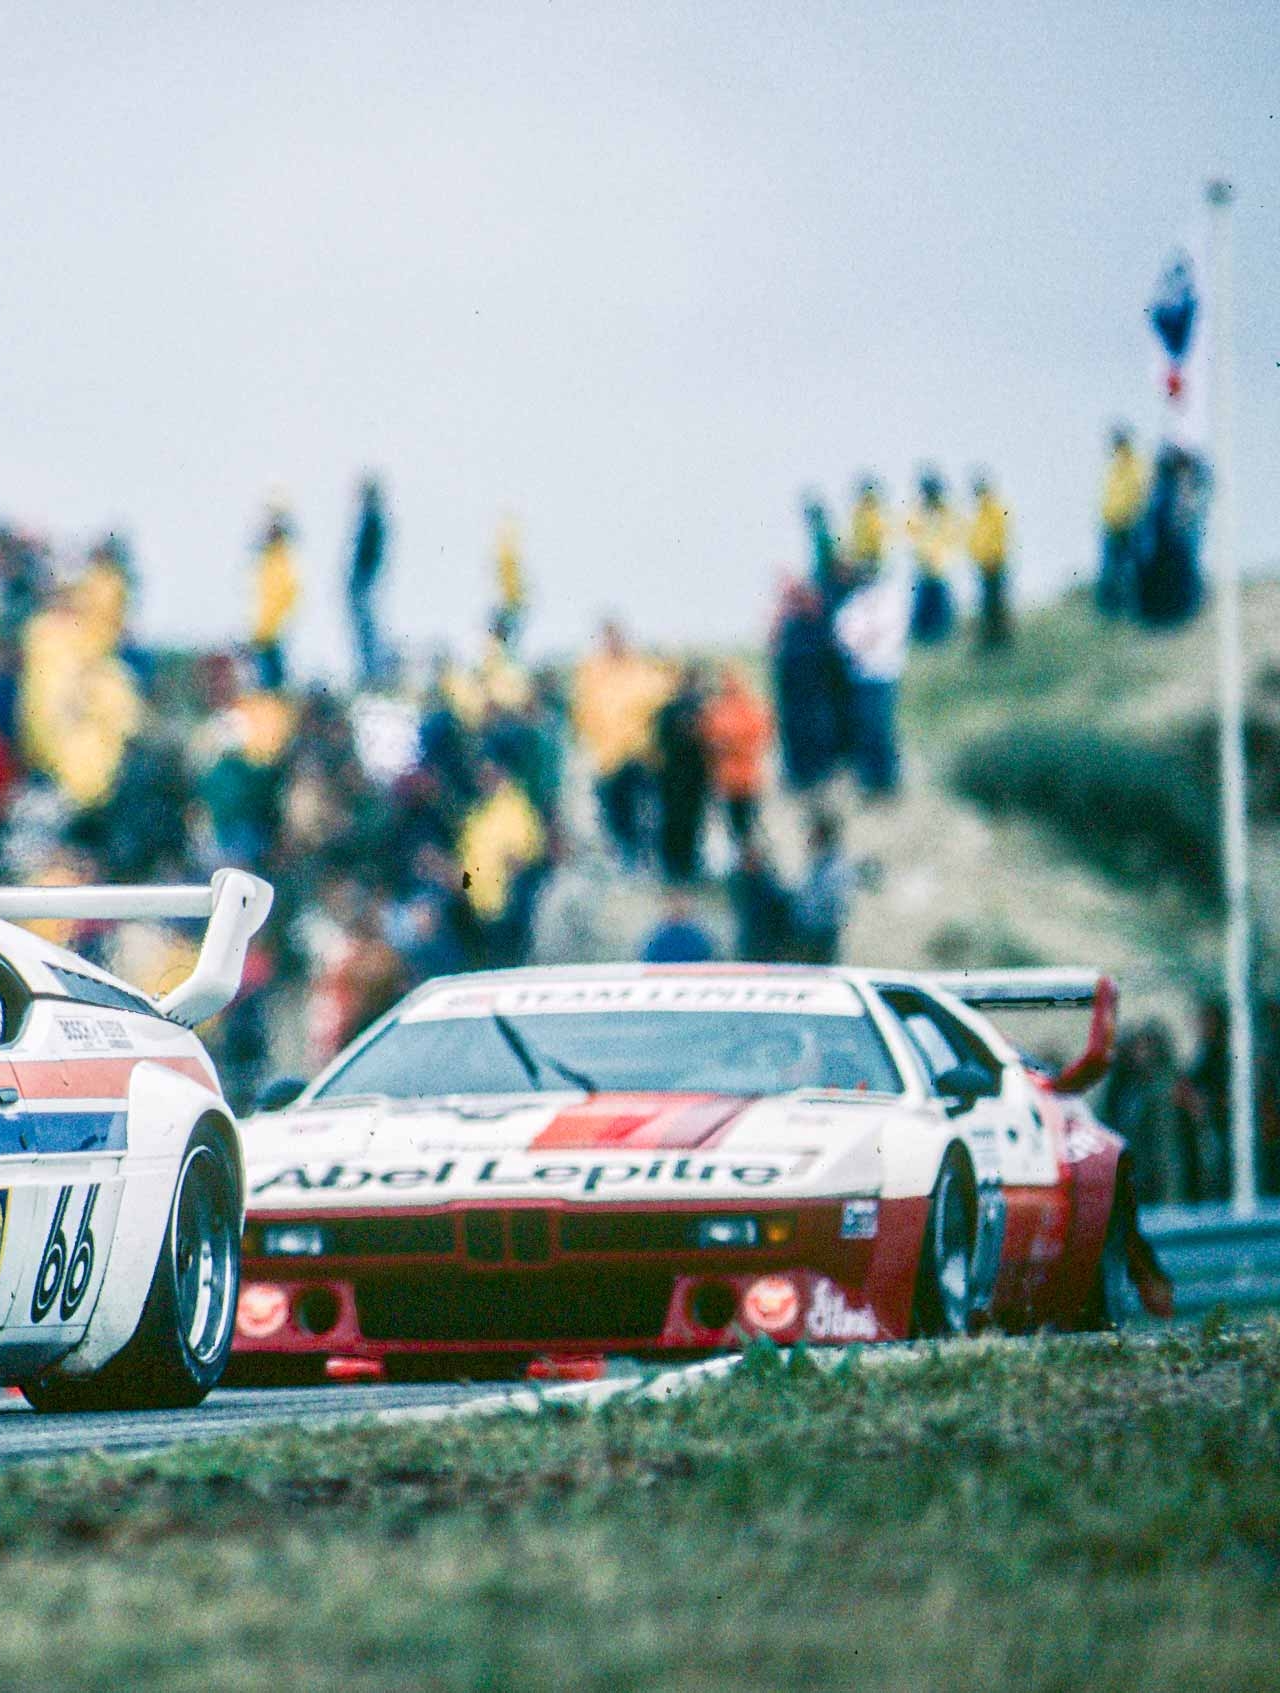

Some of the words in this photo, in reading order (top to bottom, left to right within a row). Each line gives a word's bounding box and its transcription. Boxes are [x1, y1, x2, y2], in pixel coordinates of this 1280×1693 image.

[251, 1159, 459, 1194] Abel
[473, 1156, 785, 1195] Lepitre
[30, 1182, 101, 1324] 66
